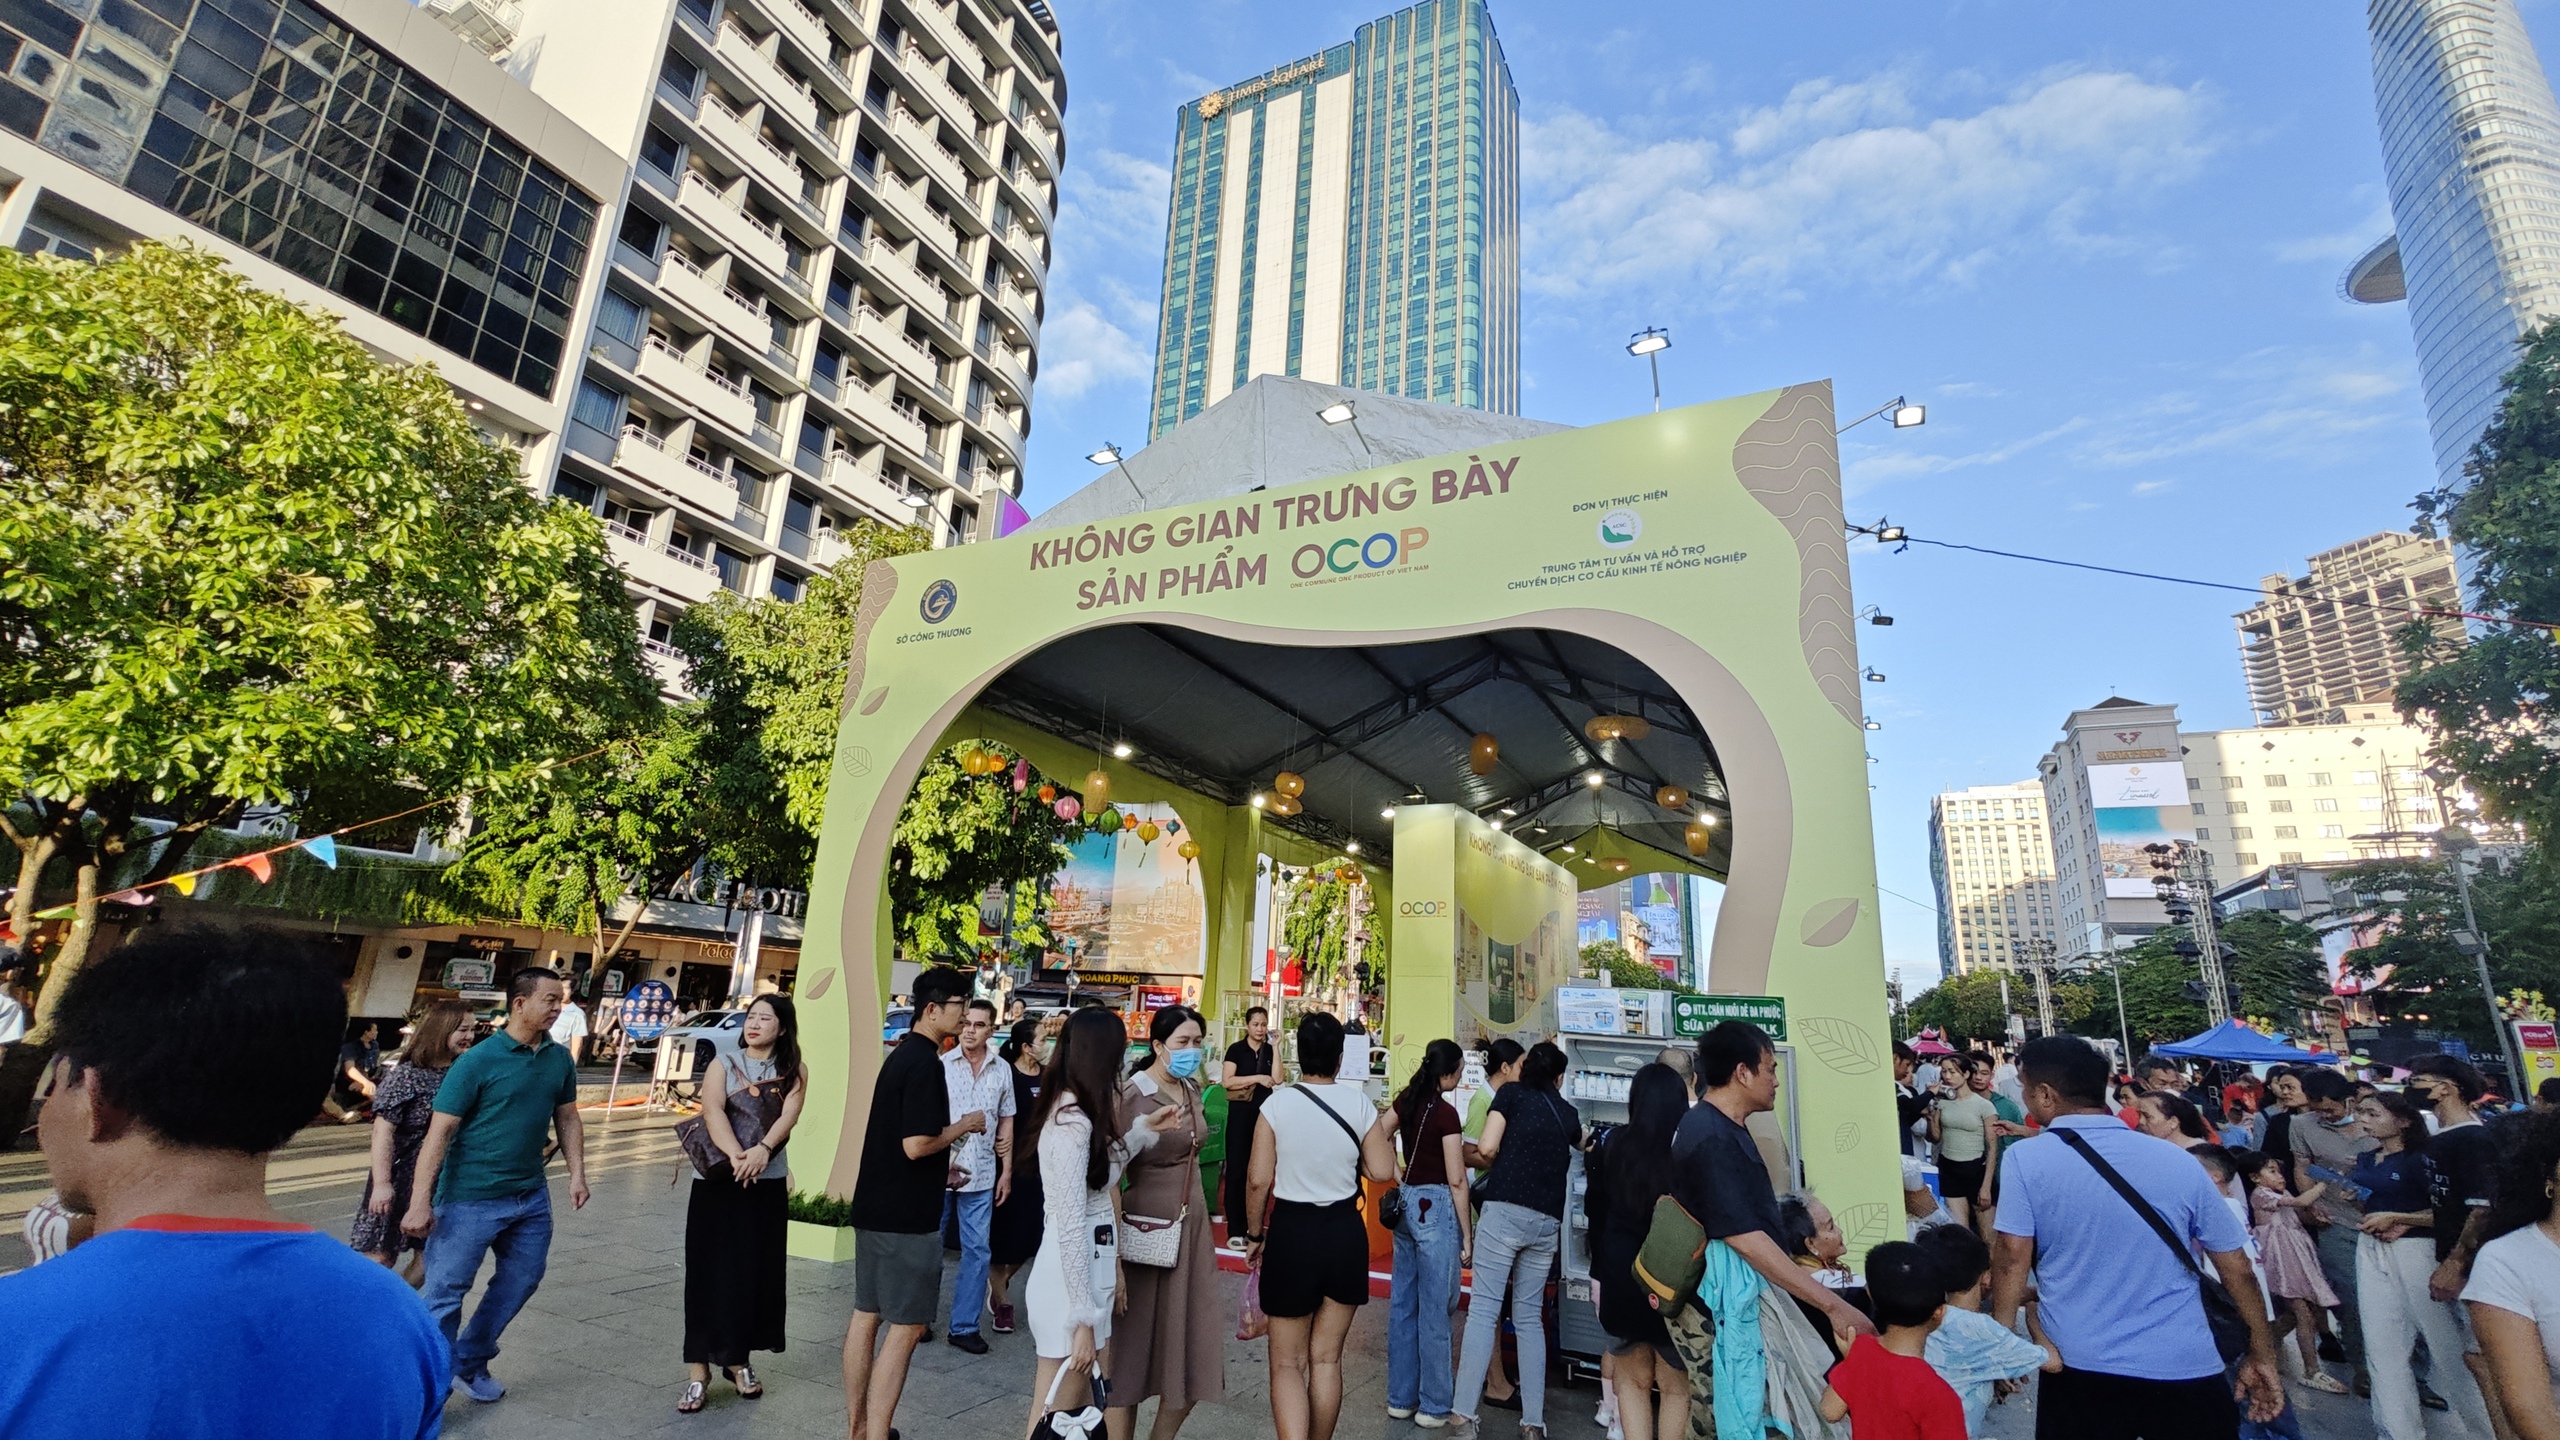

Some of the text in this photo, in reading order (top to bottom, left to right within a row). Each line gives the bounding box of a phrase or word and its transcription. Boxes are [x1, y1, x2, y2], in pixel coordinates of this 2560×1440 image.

[1228, 58, 1325, 100] TIMES SQUARE
[1573, 490, 1668, 512] ĐƠN VỊ THỰC HIỆN
[1030, 455, 1521, 570] KHÔNG GIAN TRƯNG BÀY
[1291, 527, 1429, 579] OCOP
[1542, 544, 1705, 574] TRUNG TÂM TƯ VẤN VÀ HỖ TRỢ
[1076, 545, 1268, 610] SẢN PHẨM
[1305, 577, 1337, 587] COMMUNE
[1354, 570, 1385, 580] PRODUCT
[1550, 574, 1575, 586] DỊCH
[1578, 572, 1594, 581] CƠ
[1597, 567, 1619, 579] CẤU
[1622, 565, 1647, 576] KINH
[1650, 560, 1662, 572] TẾ
[1666, 558, 1700, 570] NÔNG
[1704, 551, 1747, 565] NGHIỆP
[896, 627, 972, 644] SỞ CÔNG THƯƠNG
[1400, 901, 1447, 915] OCOP
[1079, 974, 1139, 984] HOANG PHUC
[1725, 1003, 1739, 1017] NUÔI
[1683, 1018, 1704, 1031] SỮA
